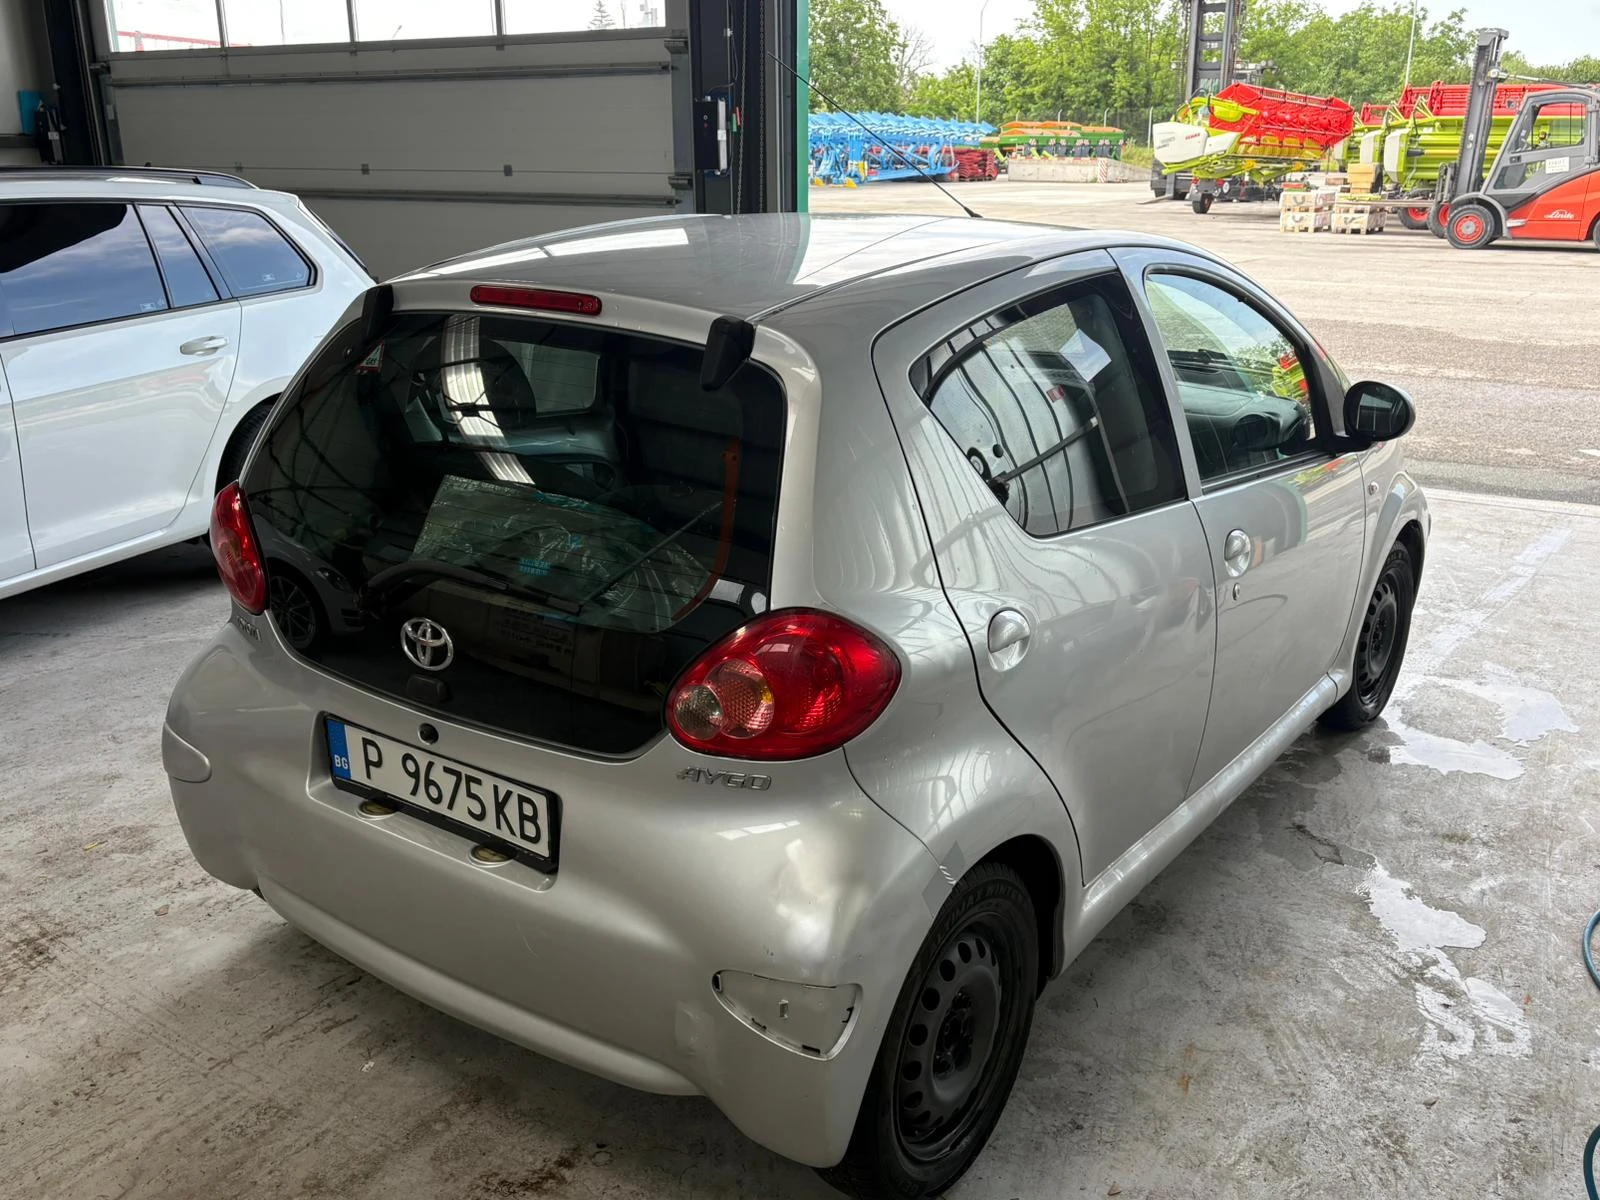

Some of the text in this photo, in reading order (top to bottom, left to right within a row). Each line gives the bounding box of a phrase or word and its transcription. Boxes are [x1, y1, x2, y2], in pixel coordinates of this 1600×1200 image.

[334, 754, 349, 770] BG
[362, 737, 383, 780] P
[676, 766, 772, 791] AYGO
